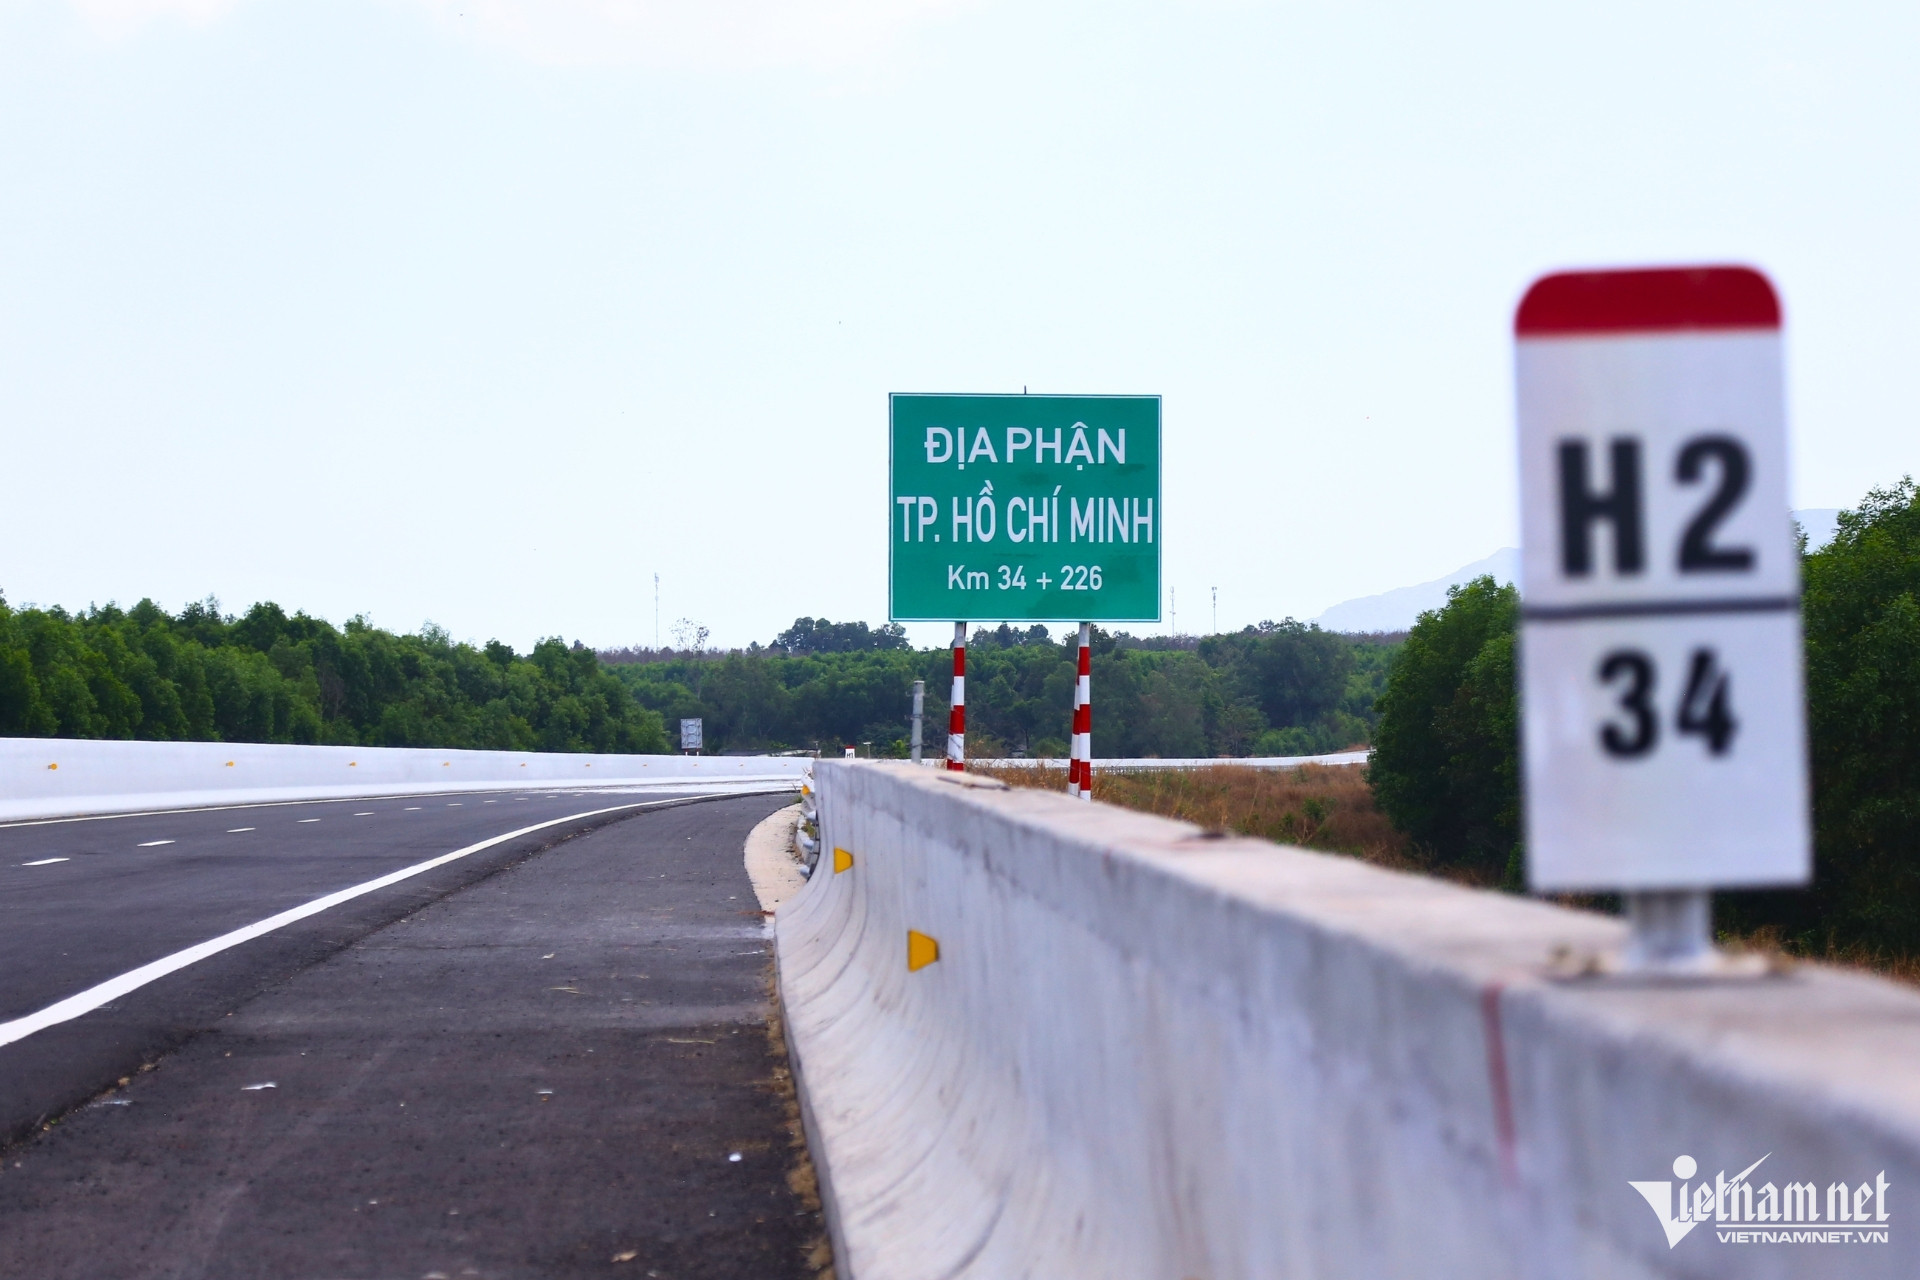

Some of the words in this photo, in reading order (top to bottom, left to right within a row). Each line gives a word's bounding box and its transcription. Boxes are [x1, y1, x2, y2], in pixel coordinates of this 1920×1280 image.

[924, 426, 998, 470] ĐỊA
[1006, 421, 1126, 470] PHẬN
[896, 496, 940, 543] TP.
[952, 480, 997, 543] HỒ
[1006, 485, 1062, 543] CHÍ
[1070, 497, 1153, 543] MINH
[1556, 433, 1757, 577] H2
[948, 564, 990, 590] Km
[997, 565, 1027, 590] 34
[1036, 572, 1053, 590] +
[1060, 565, 1103, 591] 226
[1597, 645, 1738, 762] 34
